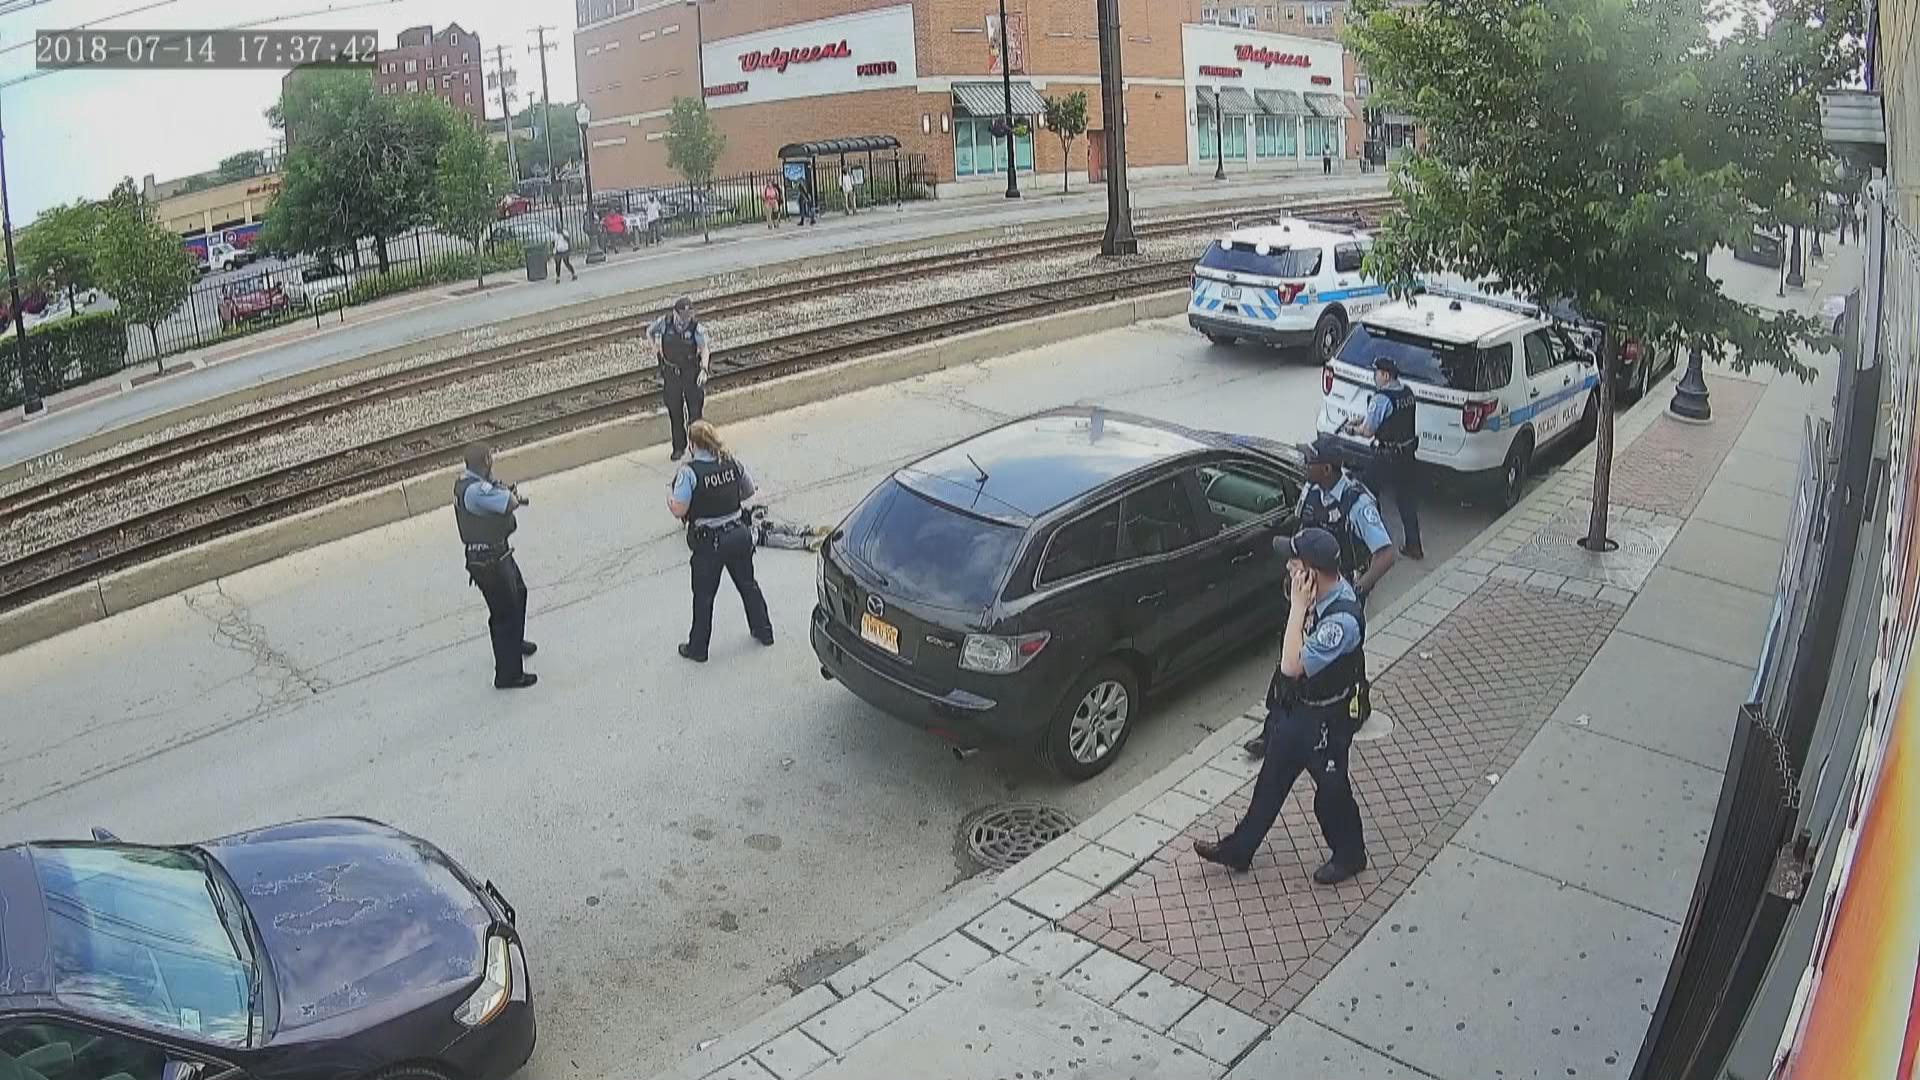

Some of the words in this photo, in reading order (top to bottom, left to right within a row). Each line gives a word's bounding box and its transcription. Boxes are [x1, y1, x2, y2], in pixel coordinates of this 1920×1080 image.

[738, 39, 852, 74] Walgreens
[1234, 45, 1311, 70] Walgreens
[857, 61, 897, 77] PHOTO
[704, 469, 736, 489] POLICE
